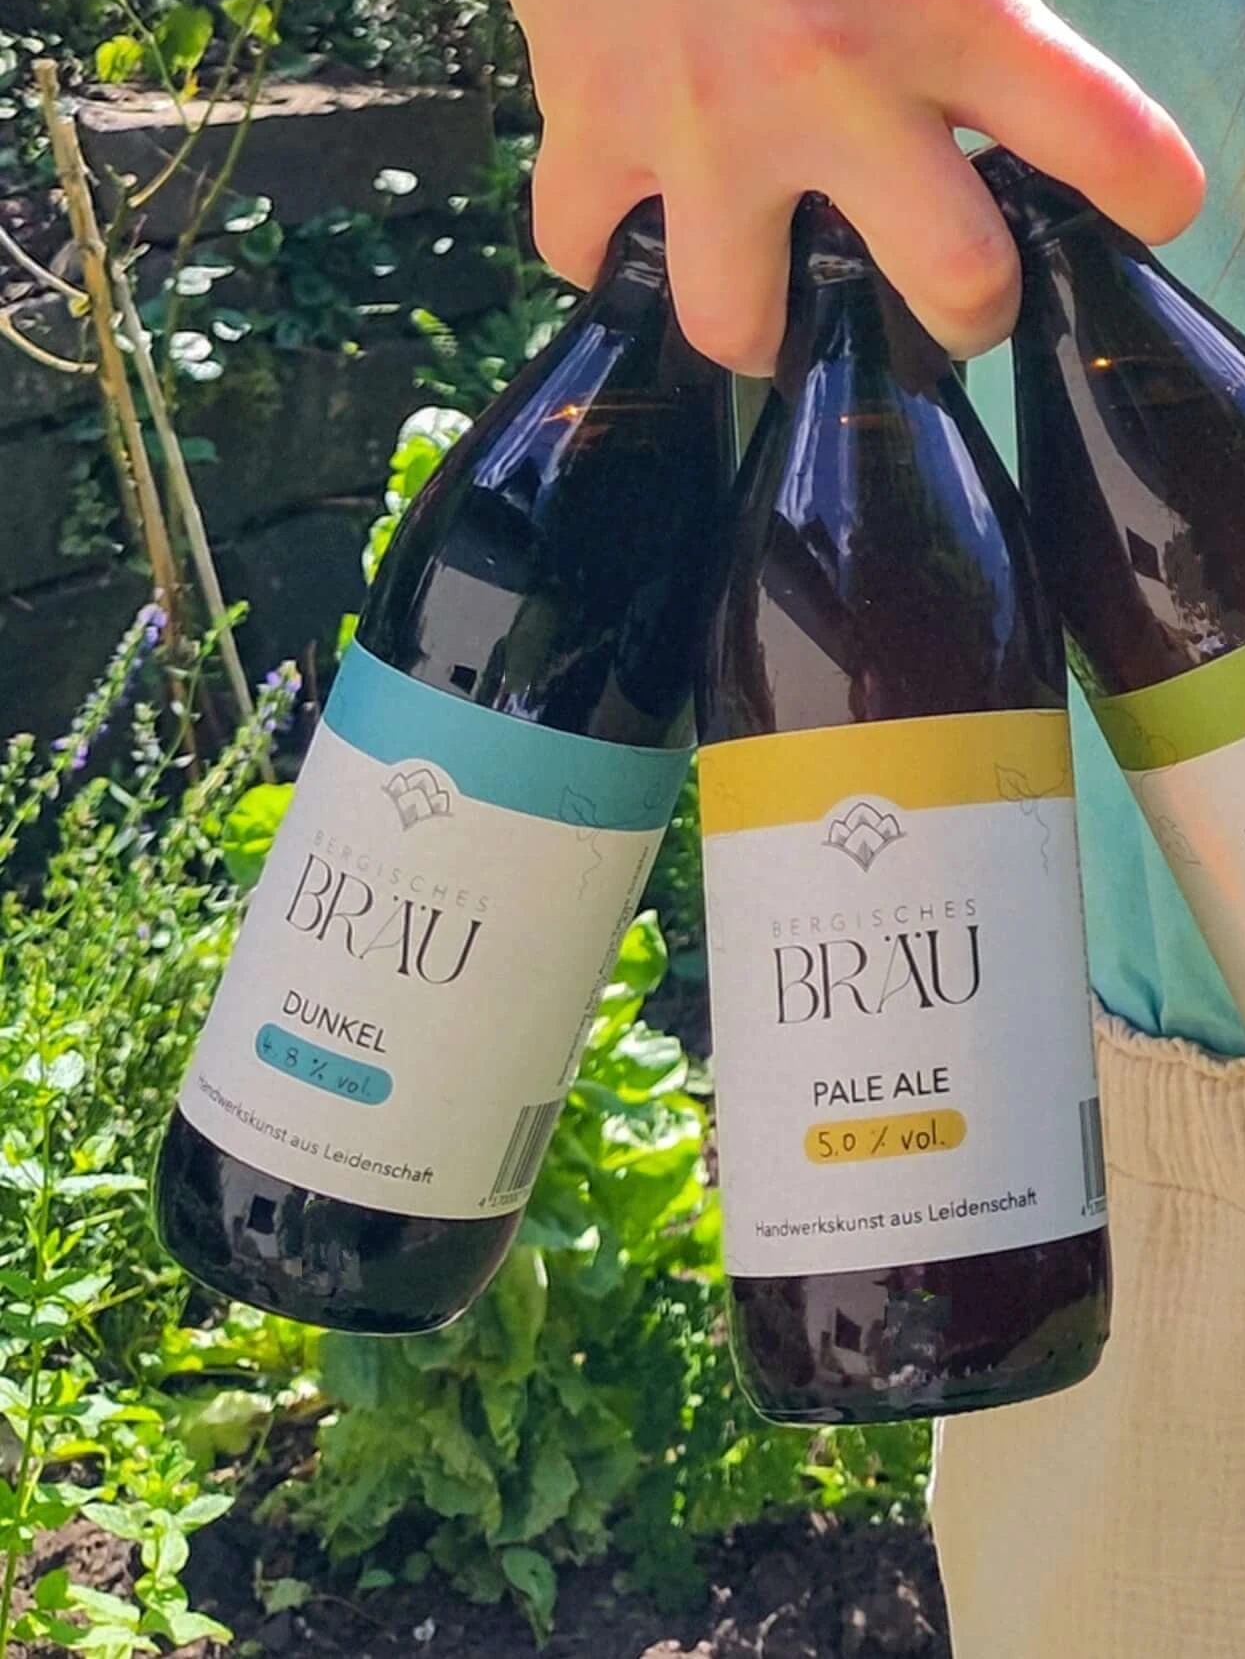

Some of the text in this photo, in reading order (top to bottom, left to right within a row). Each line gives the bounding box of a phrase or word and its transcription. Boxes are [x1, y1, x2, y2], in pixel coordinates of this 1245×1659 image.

[312, 828, 490, 912] BERGISCHES
[285, 853, 482, 985] BRÄU
[771, 897, 977, 938] BERGISCHES
[773, 924, 980, 1024] BRÄU
[282, 990, 387, 1053] DUNKEL
[813, 1067, 950, 1106] PALE ALE
[901, 1118, 946, 1151] vol.
[290, 1135, 319, 1156] aus
[323, 1143, 434, 1185] Leidenschaft
[755, 1187, 1037, 1237] Handwerkskunst aus Leidenschaft
